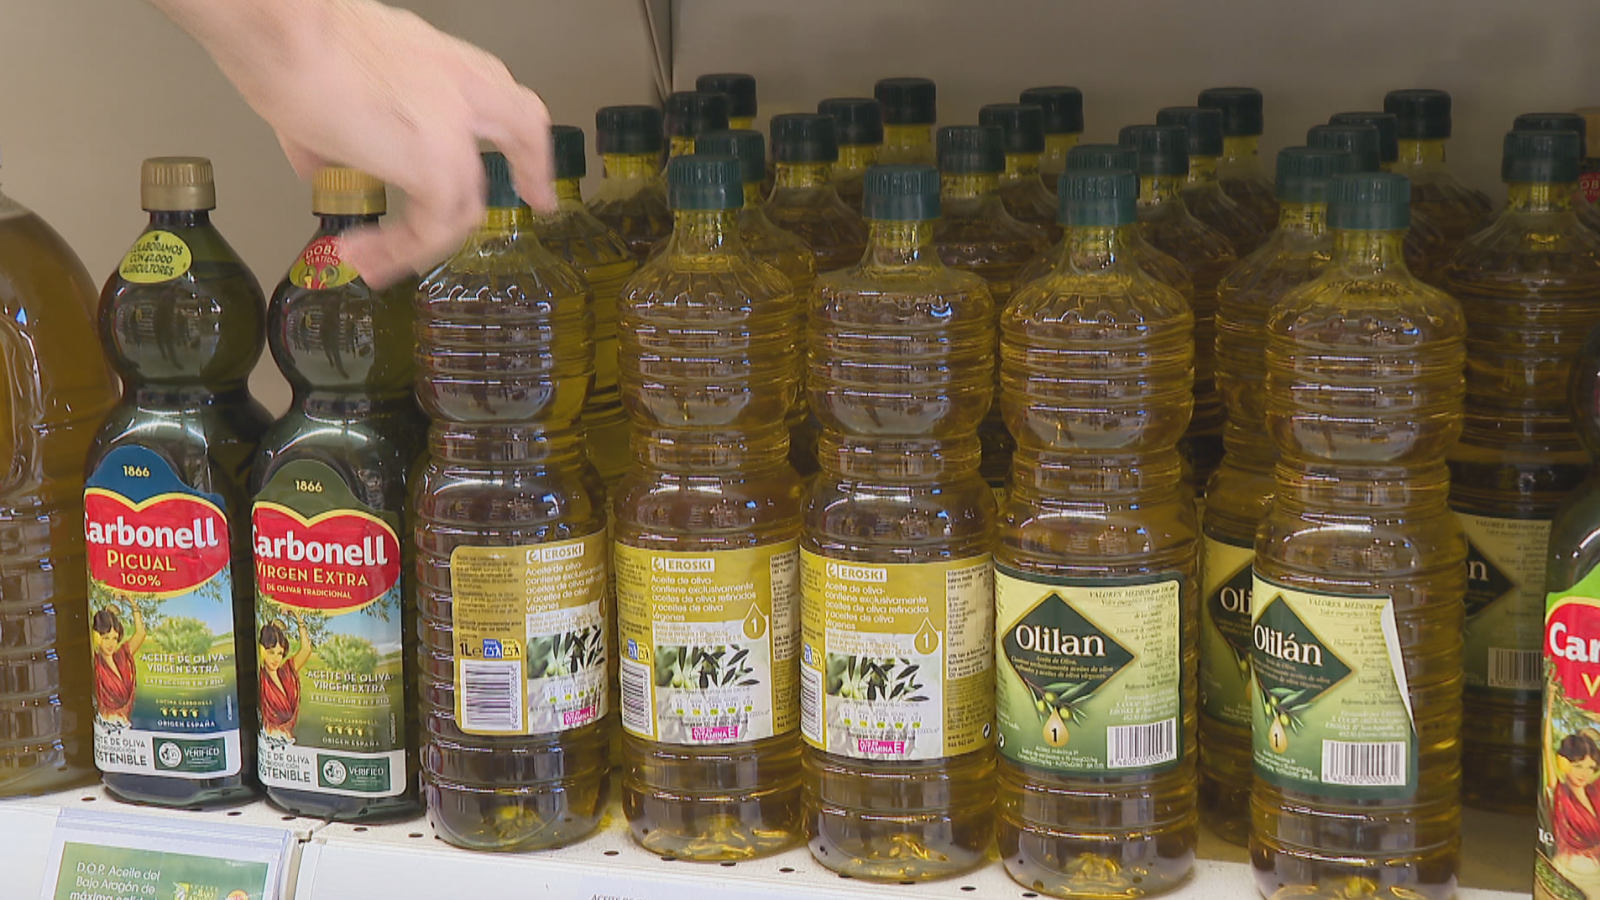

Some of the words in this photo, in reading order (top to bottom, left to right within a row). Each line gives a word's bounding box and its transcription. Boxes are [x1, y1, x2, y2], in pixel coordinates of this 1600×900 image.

[305, 245, 340, 259] DOBL
[122, 465, 151, 477] 1866
[294, 480, 323, 493] 1866
[84, 511, 219, 550] Carbonell
[252, 524, 389, 566] Carbonell
[544, 544, 583, 560] EROSKI
[106, 549, 177, 571] PICUAL
[667, 560, 712, 571] EROSKI
[256, 560, 308, 582] VIRGEN
[313, 568, 369, 586] EXTRA
[841, 567, 884, 580] EROSKI
[120, 573, 162, 587] 100%
[650, 575, 676, 584] Aceite
[677, 577, 689, 585] de
[824, 580, 848, 591] Aceite
[849, 584, 860, 593] de
[266, 583, 275, 591] DE
[276, 585, 301, 595] OLIVAR
[303, 588, 353, 600] TRADICIONAL
[651, 585, 686, 594] contiene
[688, 582, 754, 594] exclusivamente
[651, 594, 680, 603] aceites
[681, 595, 694, 603] de
[695, 595, 716, 603] oliva
[717, 591, 757, 602] refinados
[824, 591, 858, 602] contiene
[859, 595, 927, 605] exclusivamente
[657, 603, 687, 612] aceites
[688, 604, 701, 612] de
[702, 603, 723, 612] oliva
[824, 600, 851, 611] aceites
[853, 603, 864, 612] de
[866, 605, 887, 613] oliva
[888, 605, 929, 614] refinados
[830, 610, 858, 620] aceites
[859, 613, 872, 622] de
[873, 615, 895, 623] oliva
[751, 618, 757, 633] 1
[923, 632, 929, 648] 1
[1253, 624, 1323, 667] Olilán
[141, 653, 175, 663] ACEITE
[177, 654, 190, 664] DE
[193, 652, 225, 664] OLIVA
[147, 663, 183, 674] VIRGEN
[185, 664, 219, 674] EXTRA
[307, 670, 342, 680] ACEITE
[344, 672, 357, 682] DE
[359, 672, 391, 683] OLIVA
[313, 680, 350, 692] VIRGEN
[352, 683, 386, 693] EXTRA
[157, 719, 185, 728] ORIGEN
[186, 720, 216, 728] ESPAÑA
[728, 726, 736, 738] E
[1051, 727, 1058, 742] 1
[110, 737, 120, 746] DE
[122, 738, 146, 748] OLIVA
[322, 736, 349, 745] ORIGEN
[351, 739, 380, 747] ESPAÑA
[1273, 733, 1279, 748] 1
[895, 742, 902, 753] E
[95, 749, 147, 766] OSTENIBLE
[273, 753, 283, 761] DE
[286, 753, 310, 765] OLIVA
[76, 861, 105, 875] D.O.P.
[108, 865, 141, 879] Aceite
[143, 869, 160, 881] del
[76, 875, 99, 890] Bajo
[100, 879, 139, 893] Aragón
[141, 883, 155, 895] de
